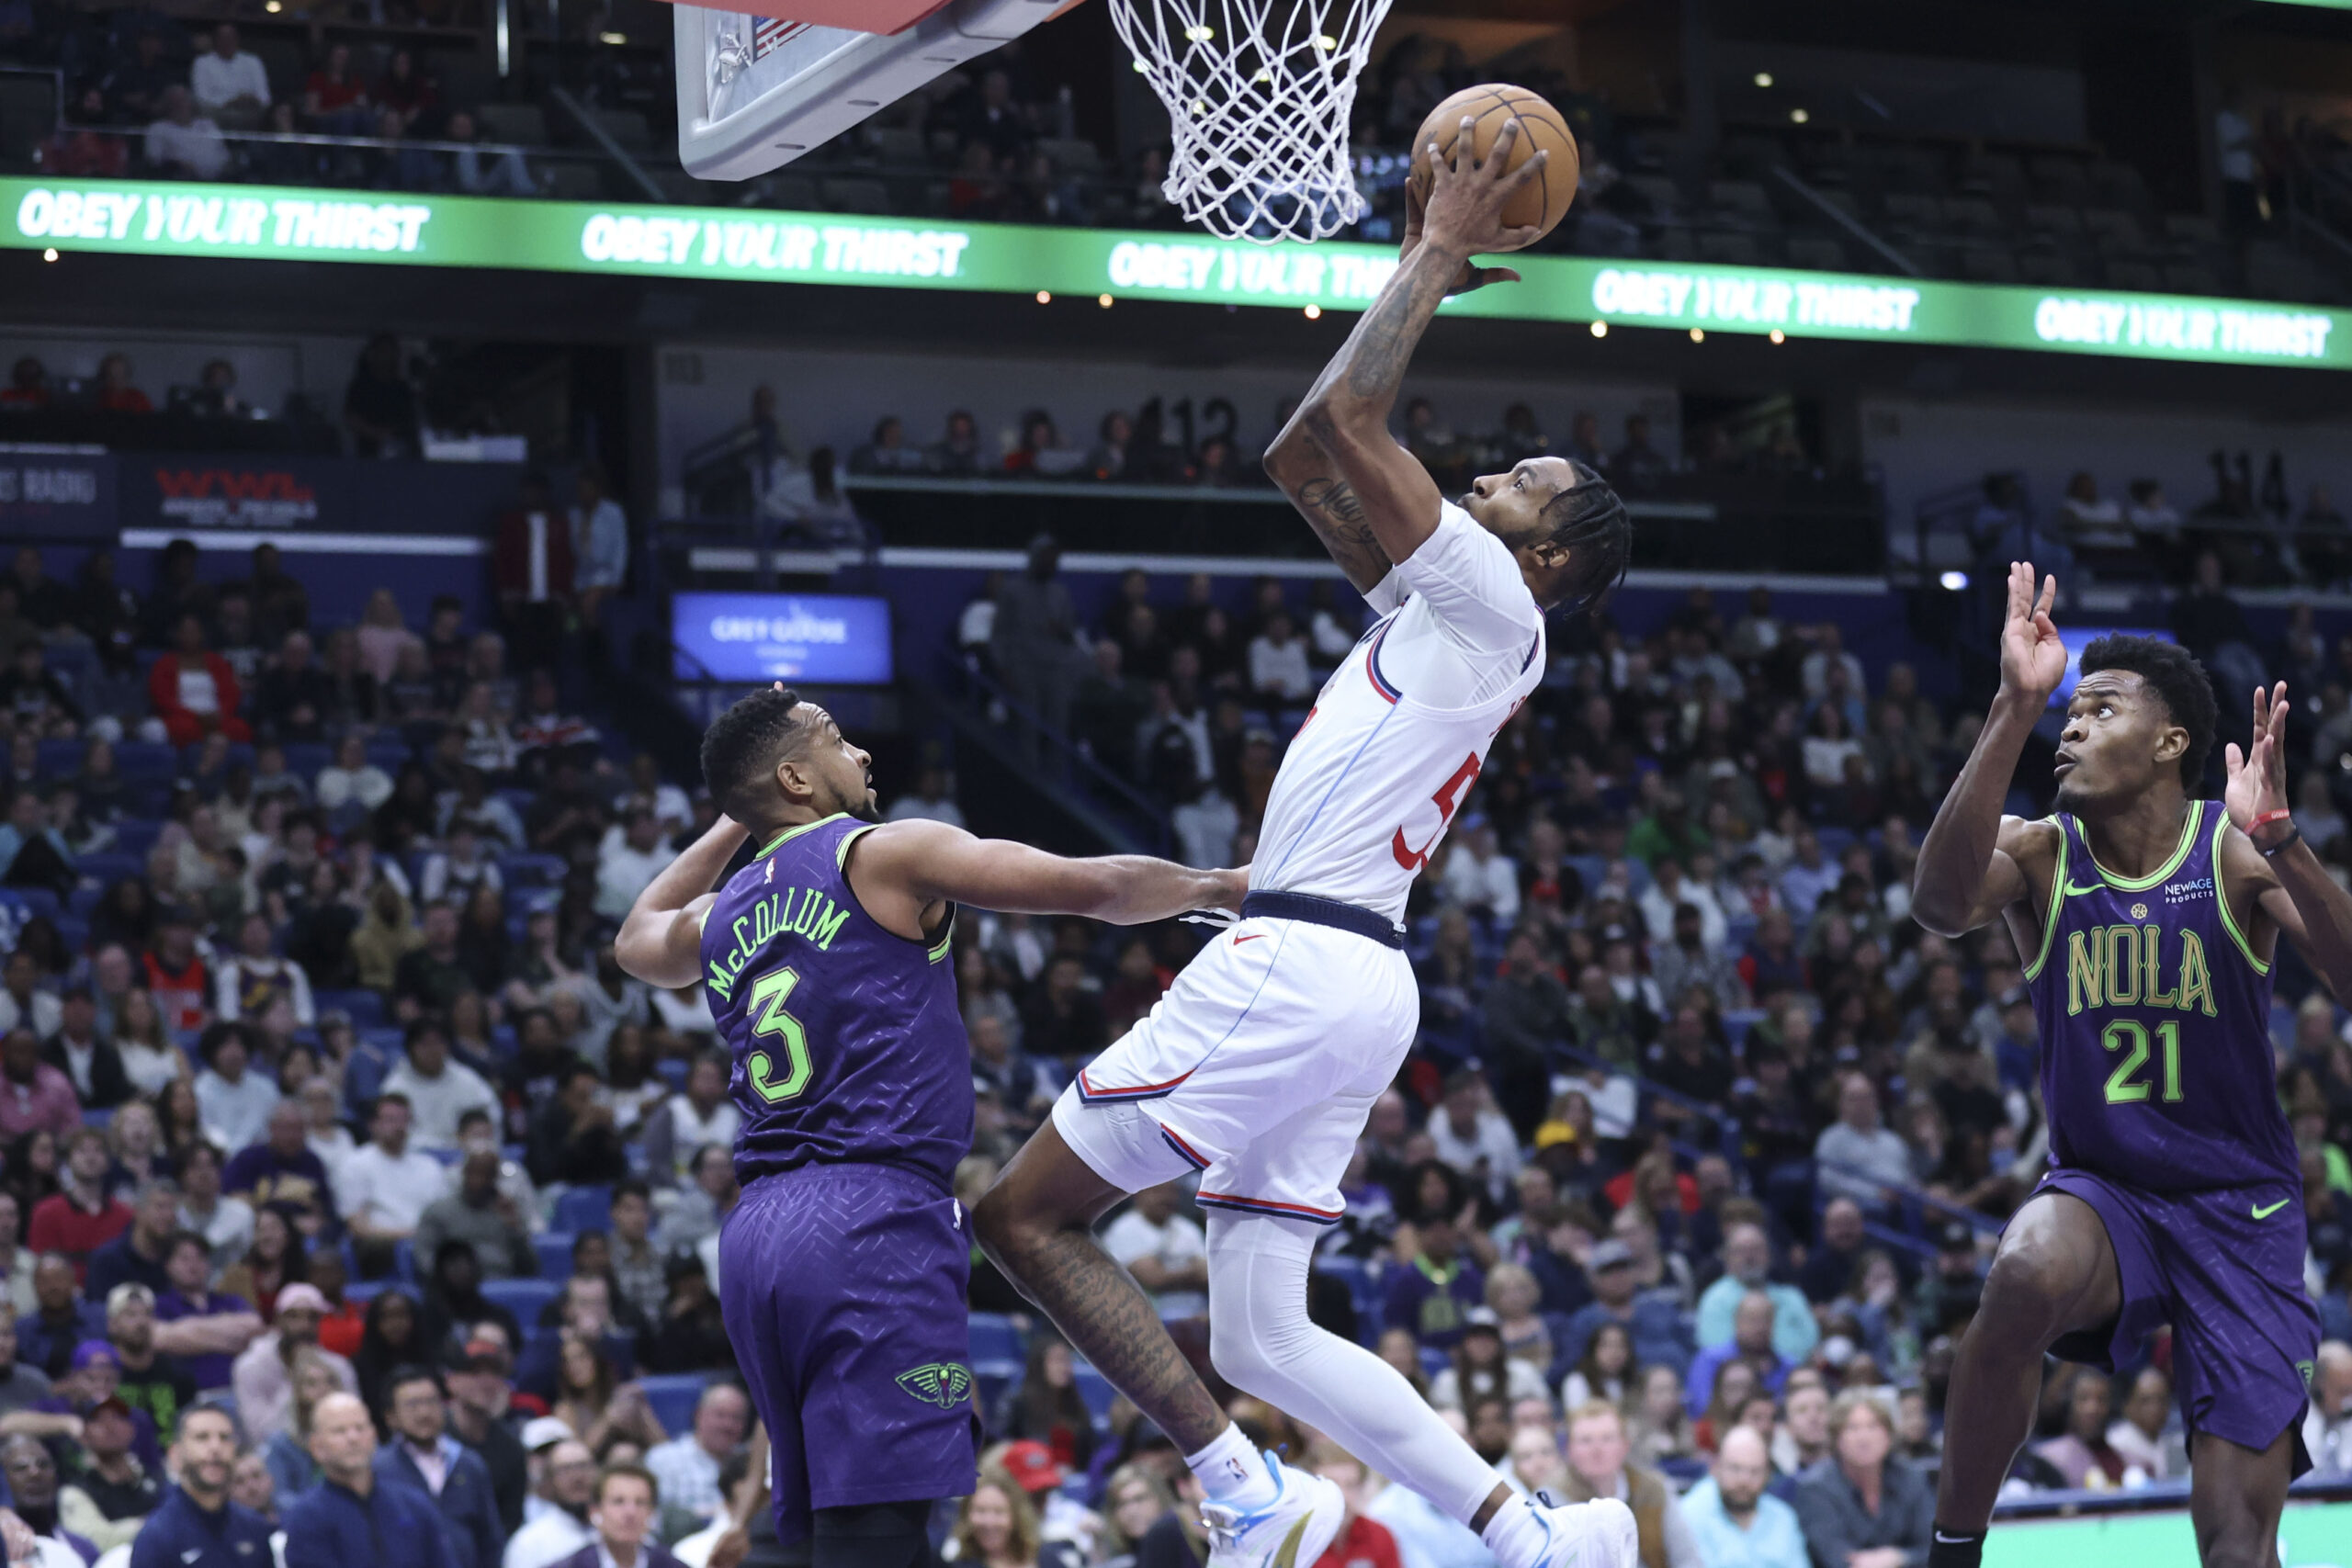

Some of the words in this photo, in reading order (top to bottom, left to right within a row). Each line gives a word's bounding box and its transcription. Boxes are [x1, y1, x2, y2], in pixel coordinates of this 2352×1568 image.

[17, 188, 141, 240] OBEY
[143, 195, 268, 245] YOUR
[271, 200, 431, 253] THIRST
[581, 213, 699, 264] OBEY
[701, 220, 819, 269] YOUR
[821, 227, 969, 277] THIRST
[1108, 242, 1217, 290] OBEY
[1219, 247, 1327, 296] YOUR
[1592, 269, 1691, 316] OBEY
[1693, 276, 1792, 323] YOUR
[1796, 282, 1919, 332] THIRST
[2035, 297, 2126, 344] OBEY
[2128, 302, 2217, 351] YOUR
[2220, 310, 2333, 358] THIRST
[2165, 889, 2214, 904] PRODUCTS
[2067, 923, 2219, 1018] NOLA
[746, 964, 814, 1105] 3
[2101, 1018, 2185, 1105] 21
